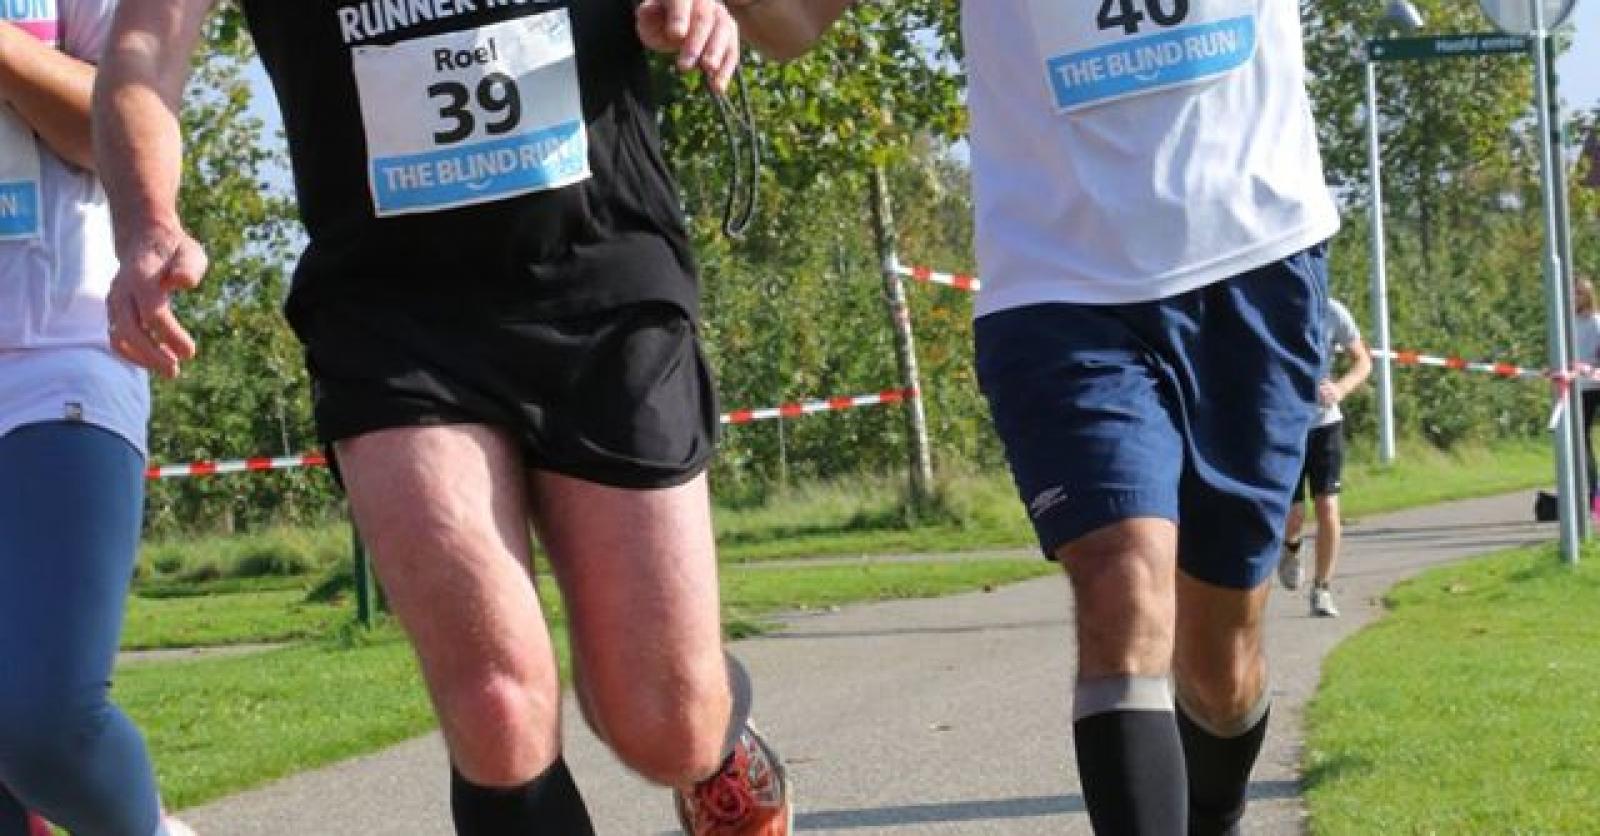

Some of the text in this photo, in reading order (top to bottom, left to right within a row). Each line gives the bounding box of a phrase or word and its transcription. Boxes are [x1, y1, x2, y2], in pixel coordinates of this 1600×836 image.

[433, 37, 498, 72] Roel
[1060, 30, 1236, 88] THE BLIND RUN
[427, 72, 521, 145] 39
[385, 165, 434, 191] THE
[437, 150, 517, 183] BLIND
